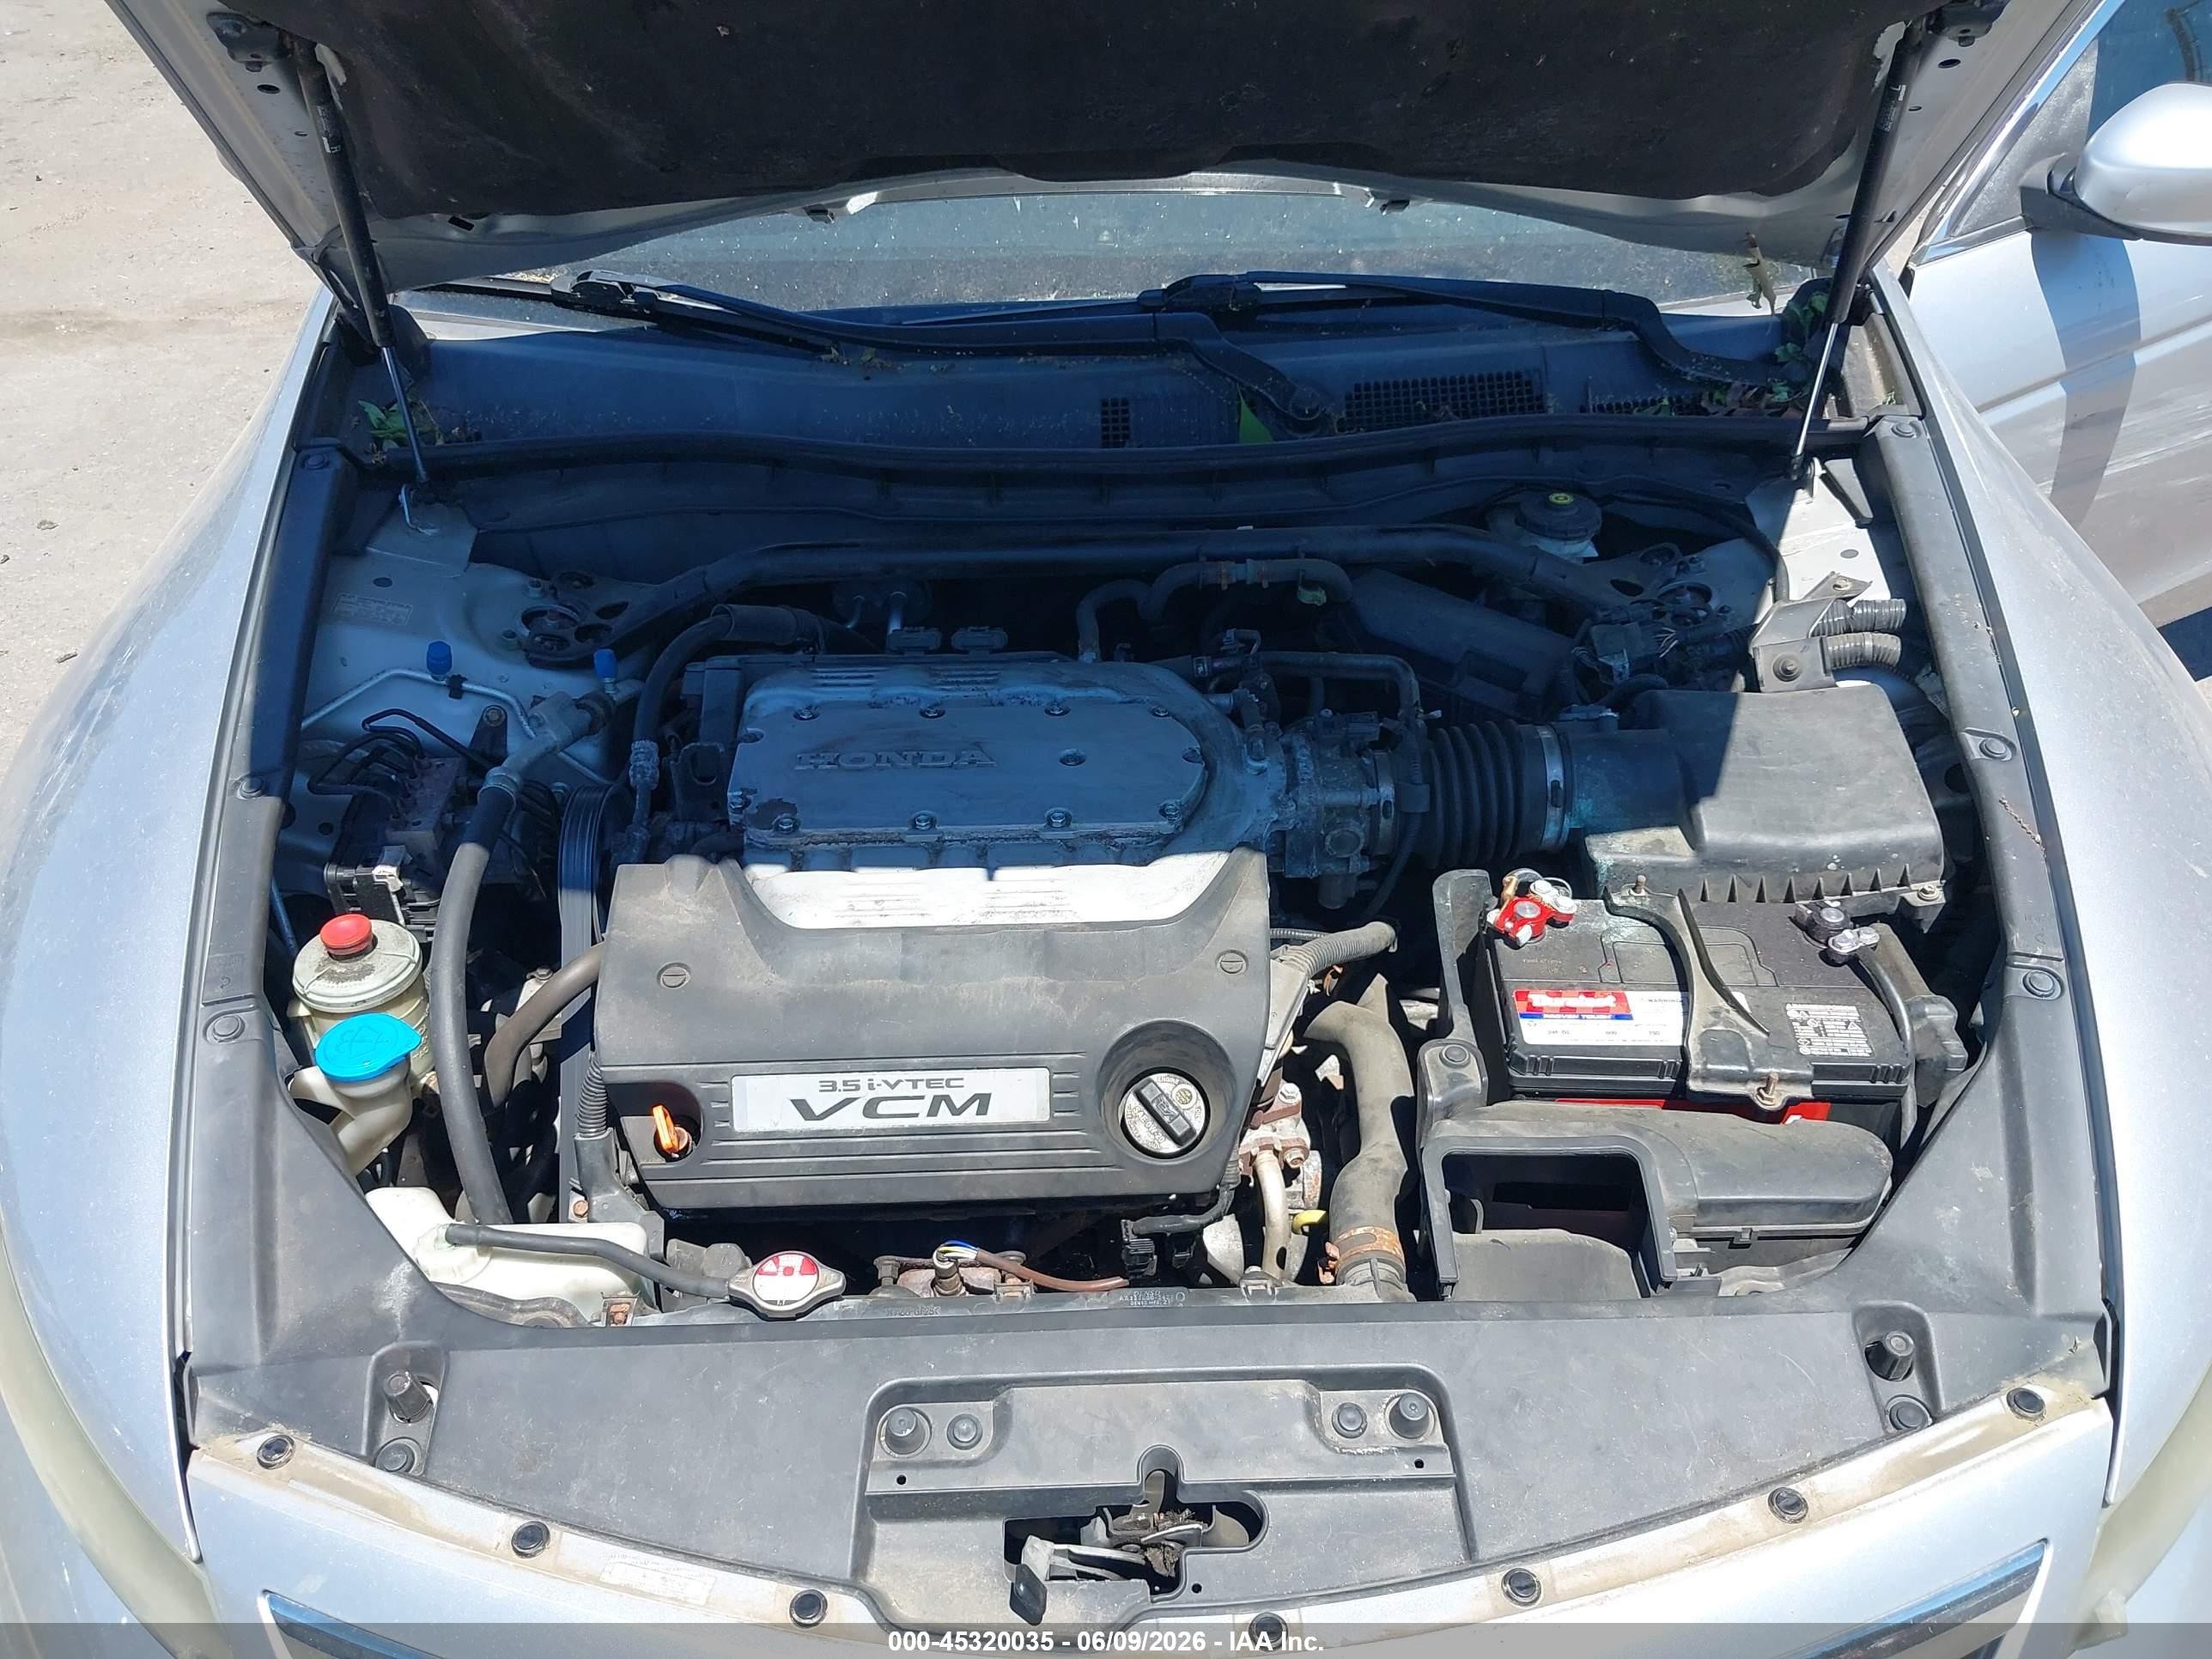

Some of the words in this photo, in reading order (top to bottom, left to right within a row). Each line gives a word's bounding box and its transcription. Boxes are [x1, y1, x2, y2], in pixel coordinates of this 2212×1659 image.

[794, 750, 997, 770] HONDA
[818, 1079, 860, 1093] 3.5
[867, 1077, 964, 1091] i-VTEC
[790, 1092, 992, 1121] VCM
[1132, 1105, 1148, 1123] SAE
